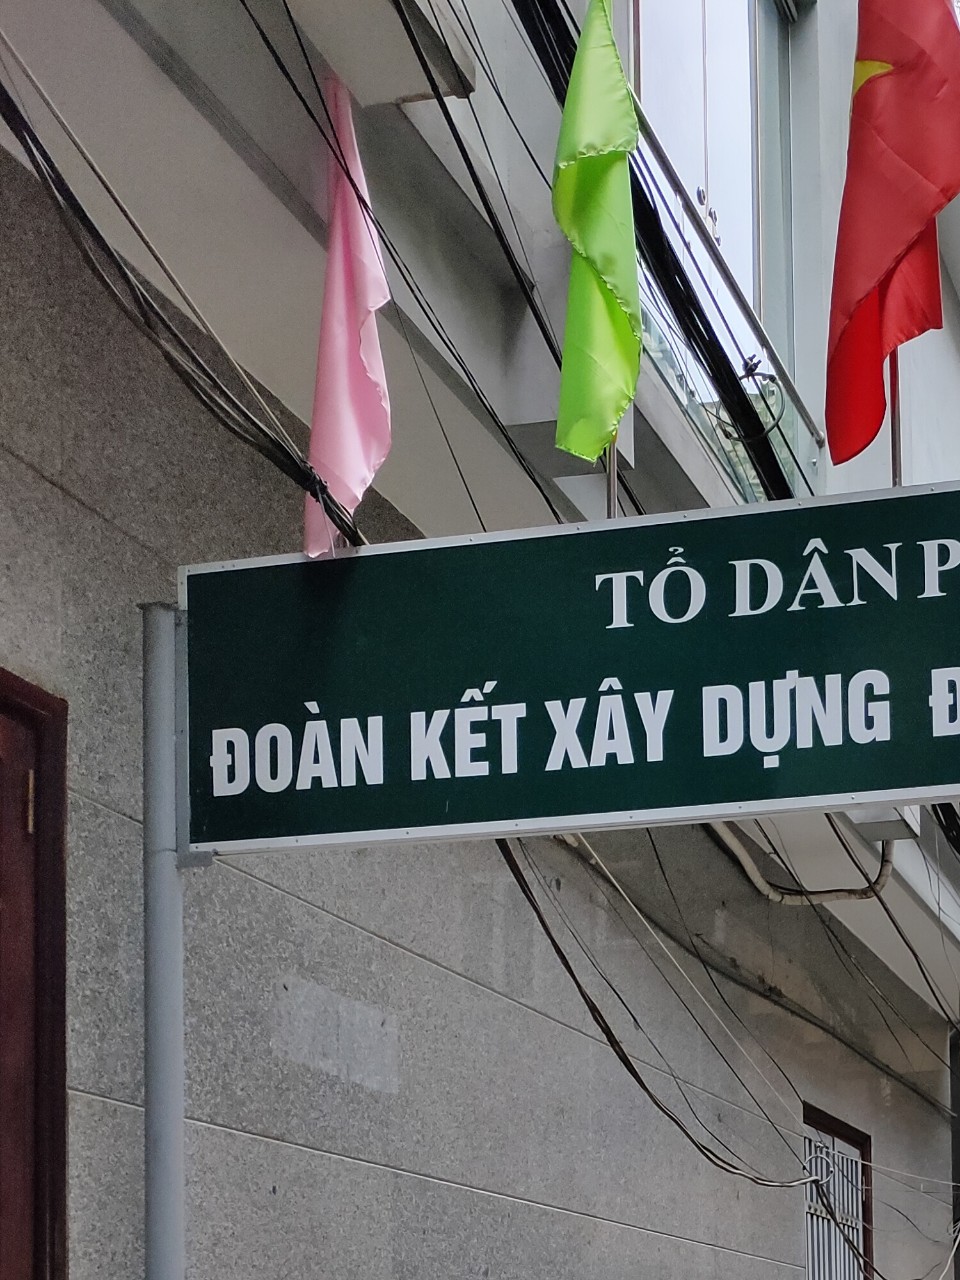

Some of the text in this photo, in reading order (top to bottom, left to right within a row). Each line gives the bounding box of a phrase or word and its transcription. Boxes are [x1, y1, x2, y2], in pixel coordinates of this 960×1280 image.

[595, 547, 707, 629] TỔ
[728, 538, 903, 617] DÂN
[209, 702, 384, 797] ĐOÀN
[410, 680, 527, 781] KẾT
[544, 677, 675, 772] XÂY
[702, 669, 891, 769] DỰNG
